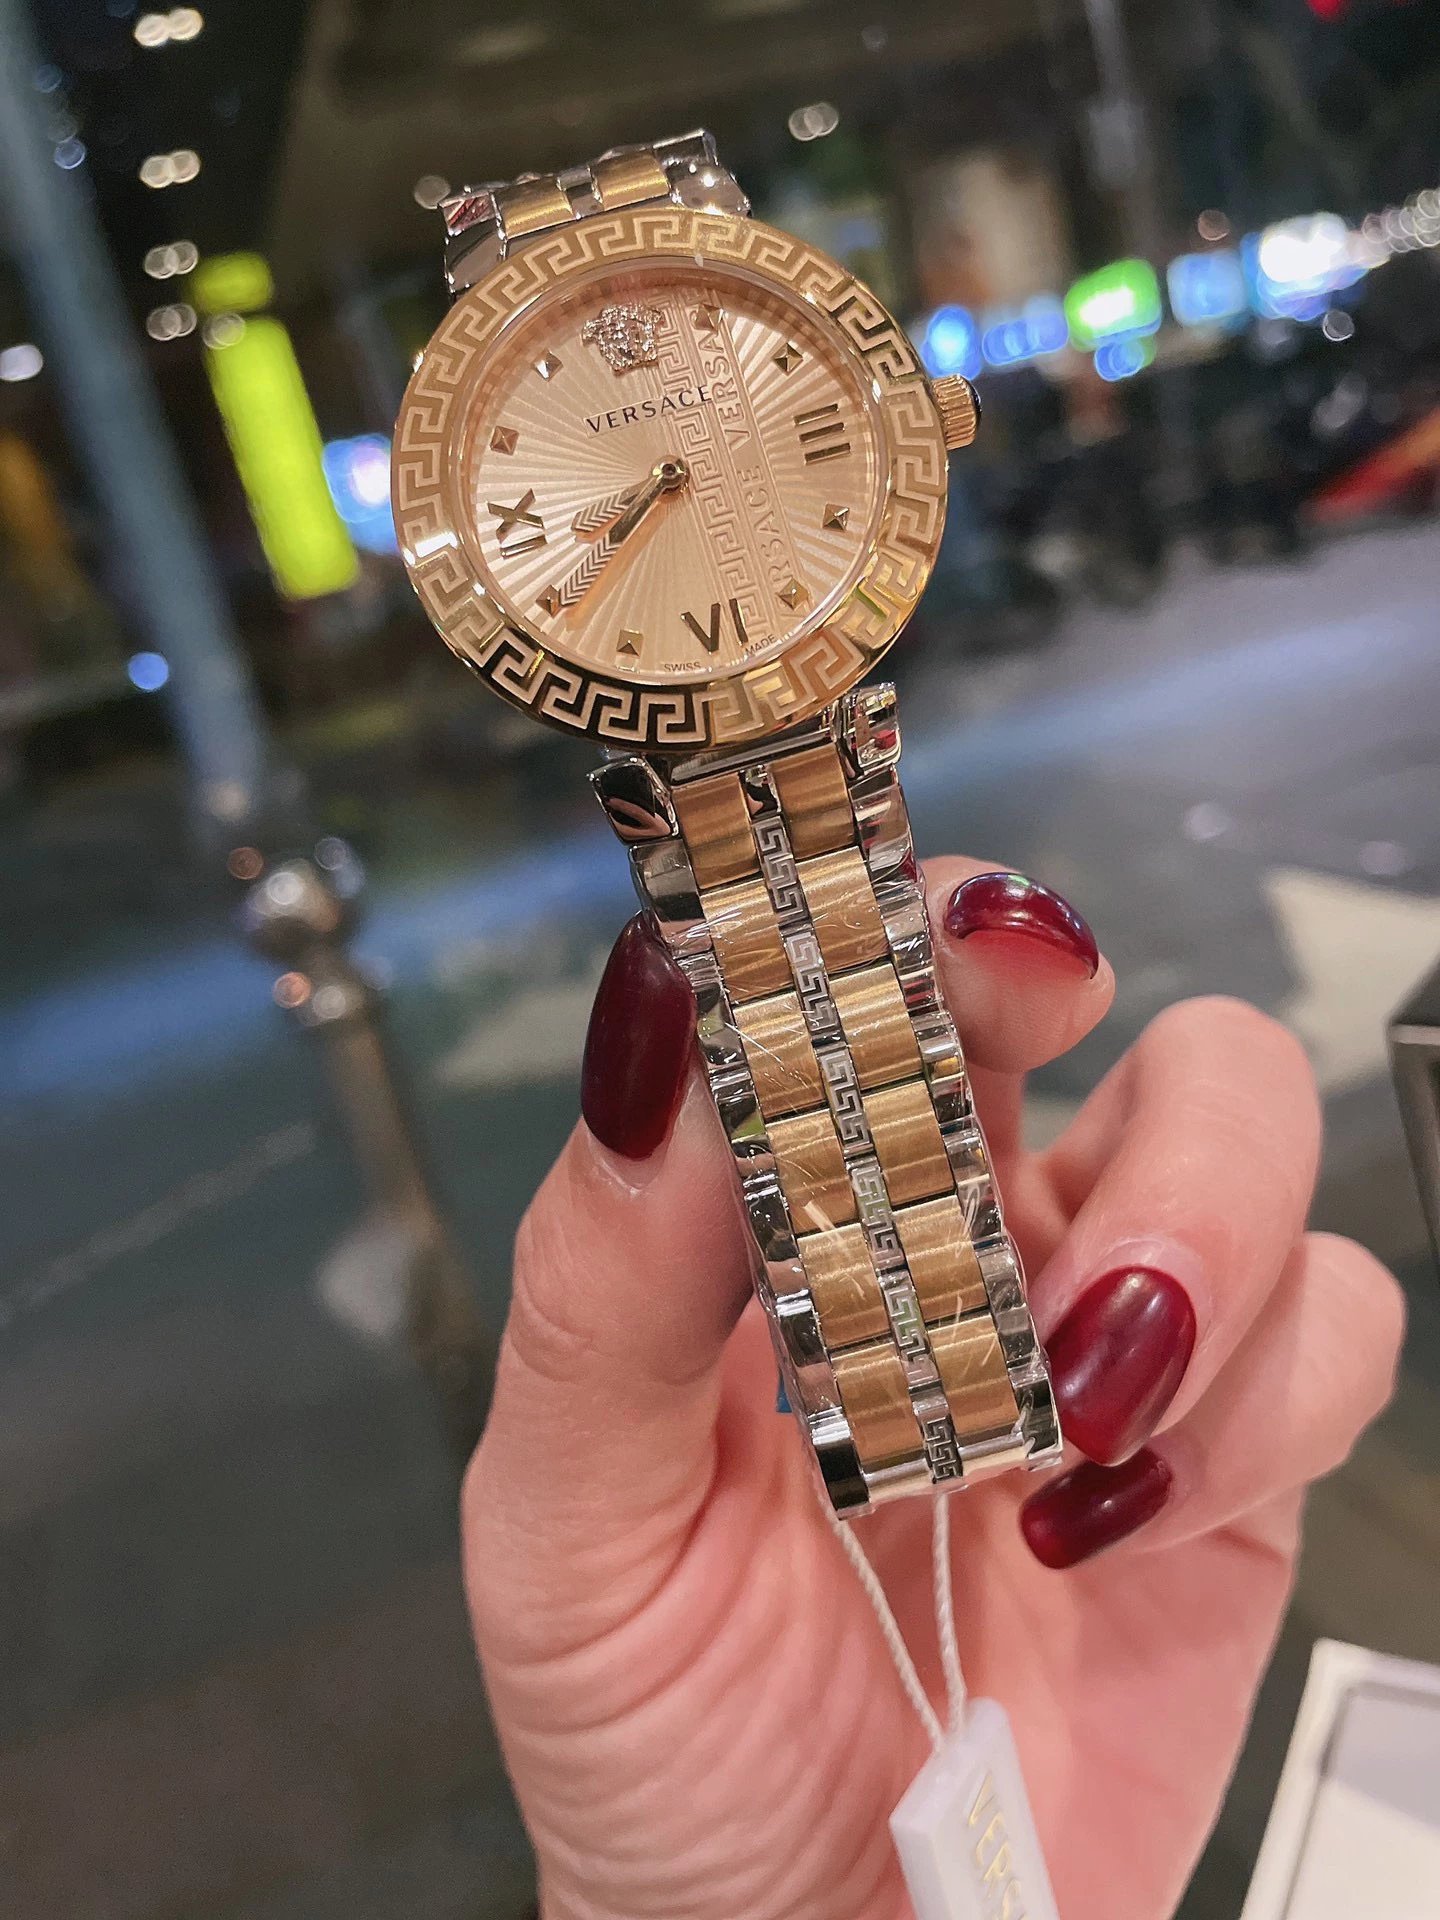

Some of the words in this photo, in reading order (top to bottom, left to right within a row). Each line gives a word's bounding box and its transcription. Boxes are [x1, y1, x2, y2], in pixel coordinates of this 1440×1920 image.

[586, 384, 712, 433] VERSACE
[793, 403, 851, 465] III
[663, 661, 701, 673] SWISS
[744, 633, 778, 657] MADE
[680, 598, 749, 655] VI
[967, 1768, 1030, 1920] VERS
